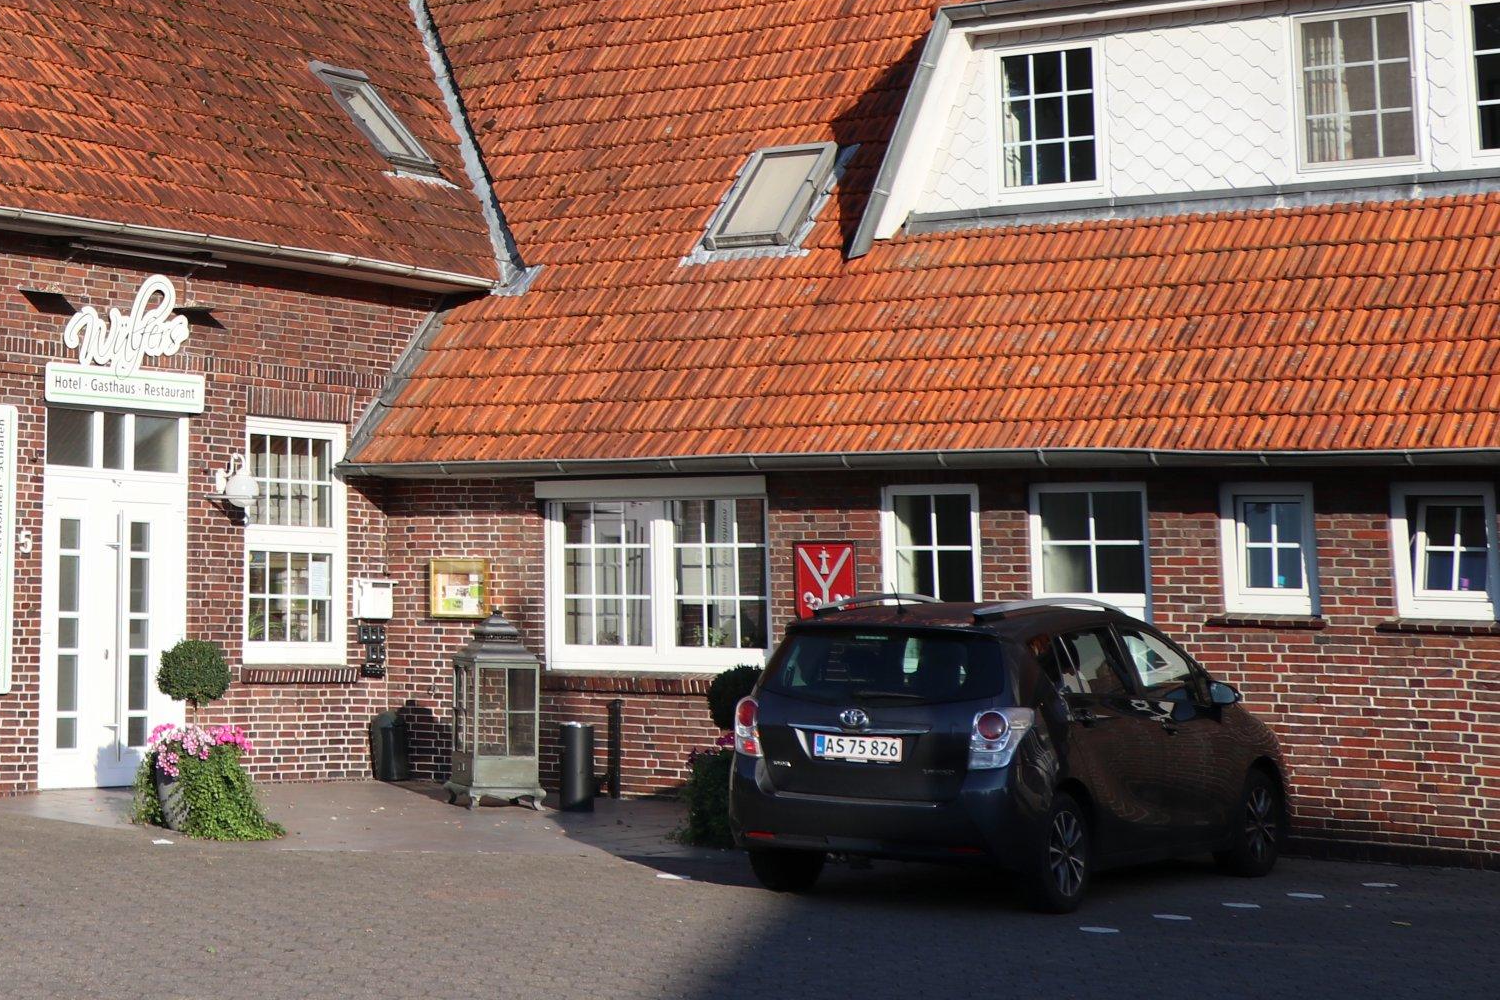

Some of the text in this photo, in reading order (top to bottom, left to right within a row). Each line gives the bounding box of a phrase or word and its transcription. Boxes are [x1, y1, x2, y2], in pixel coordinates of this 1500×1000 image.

[66, 276, 187, 380] Wülfers
[54, 375, 196, 400] Hotel Gasthaus Restaurant
[19, 530, 32, 553] 5
[826, 738, 898, 757] AS 75 826
